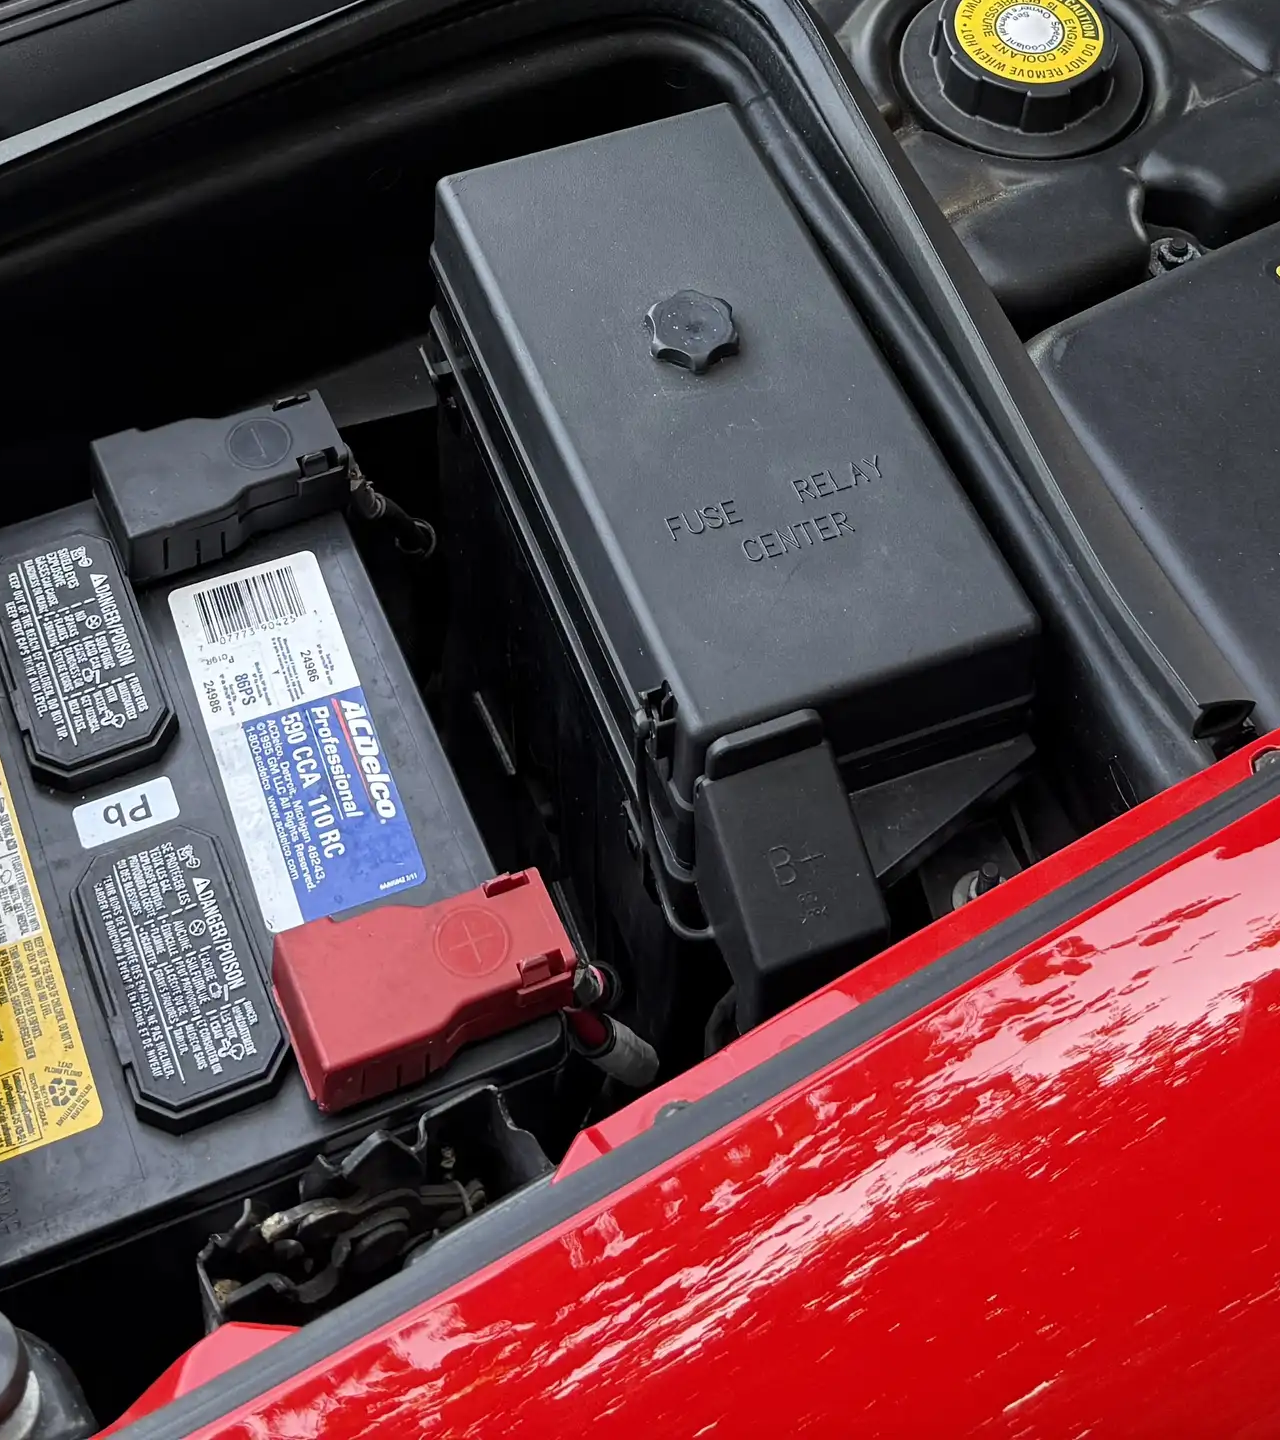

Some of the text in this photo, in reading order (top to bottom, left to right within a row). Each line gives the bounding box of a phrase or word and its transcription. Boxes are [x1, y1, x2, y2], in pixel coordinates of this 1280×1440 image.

[1046, 2, 1058, 11] 15
[961, 29, 1096, 79] DO NOT REMOVE WHEN HOT
[992, 19, 1077, 63] ENGINE COOLANT
[664, 454, 882, 541] FUSE RELAY
[741, 512, 856, 562] CENTER
[94, 583, 135, 667] DANGER/POISON
[299, 649, 319, 683] 24986
[203, 679, 222, 713] 24986
[234, 672, 256, 706] 86PS
[279, 711, 308, 745] 590
[266, 756, 279, 774] GM
[290, 744, 322, 788] CCA
[310, 704, 363, 819] Professional
[272, 775, 286, 795] LLC
[277, 760, 298, 798] Detroit,
[289, 799, 312, 843] Michigan
[279, 796, 290, 809] All
[103, 793, 153, 828] Pb
[245, 726, 272, 790] 1-800-acdelco
[266, 794, 301, 880] www.acdelco.com
[306, 793, 336, 828] 110
[282, 810, 300, 842] Rights
[317, 828, 346, 859] RC
[294, 843, 317, 892] Reserved.
[196, 888, 246, 991] DANGER/POISON
